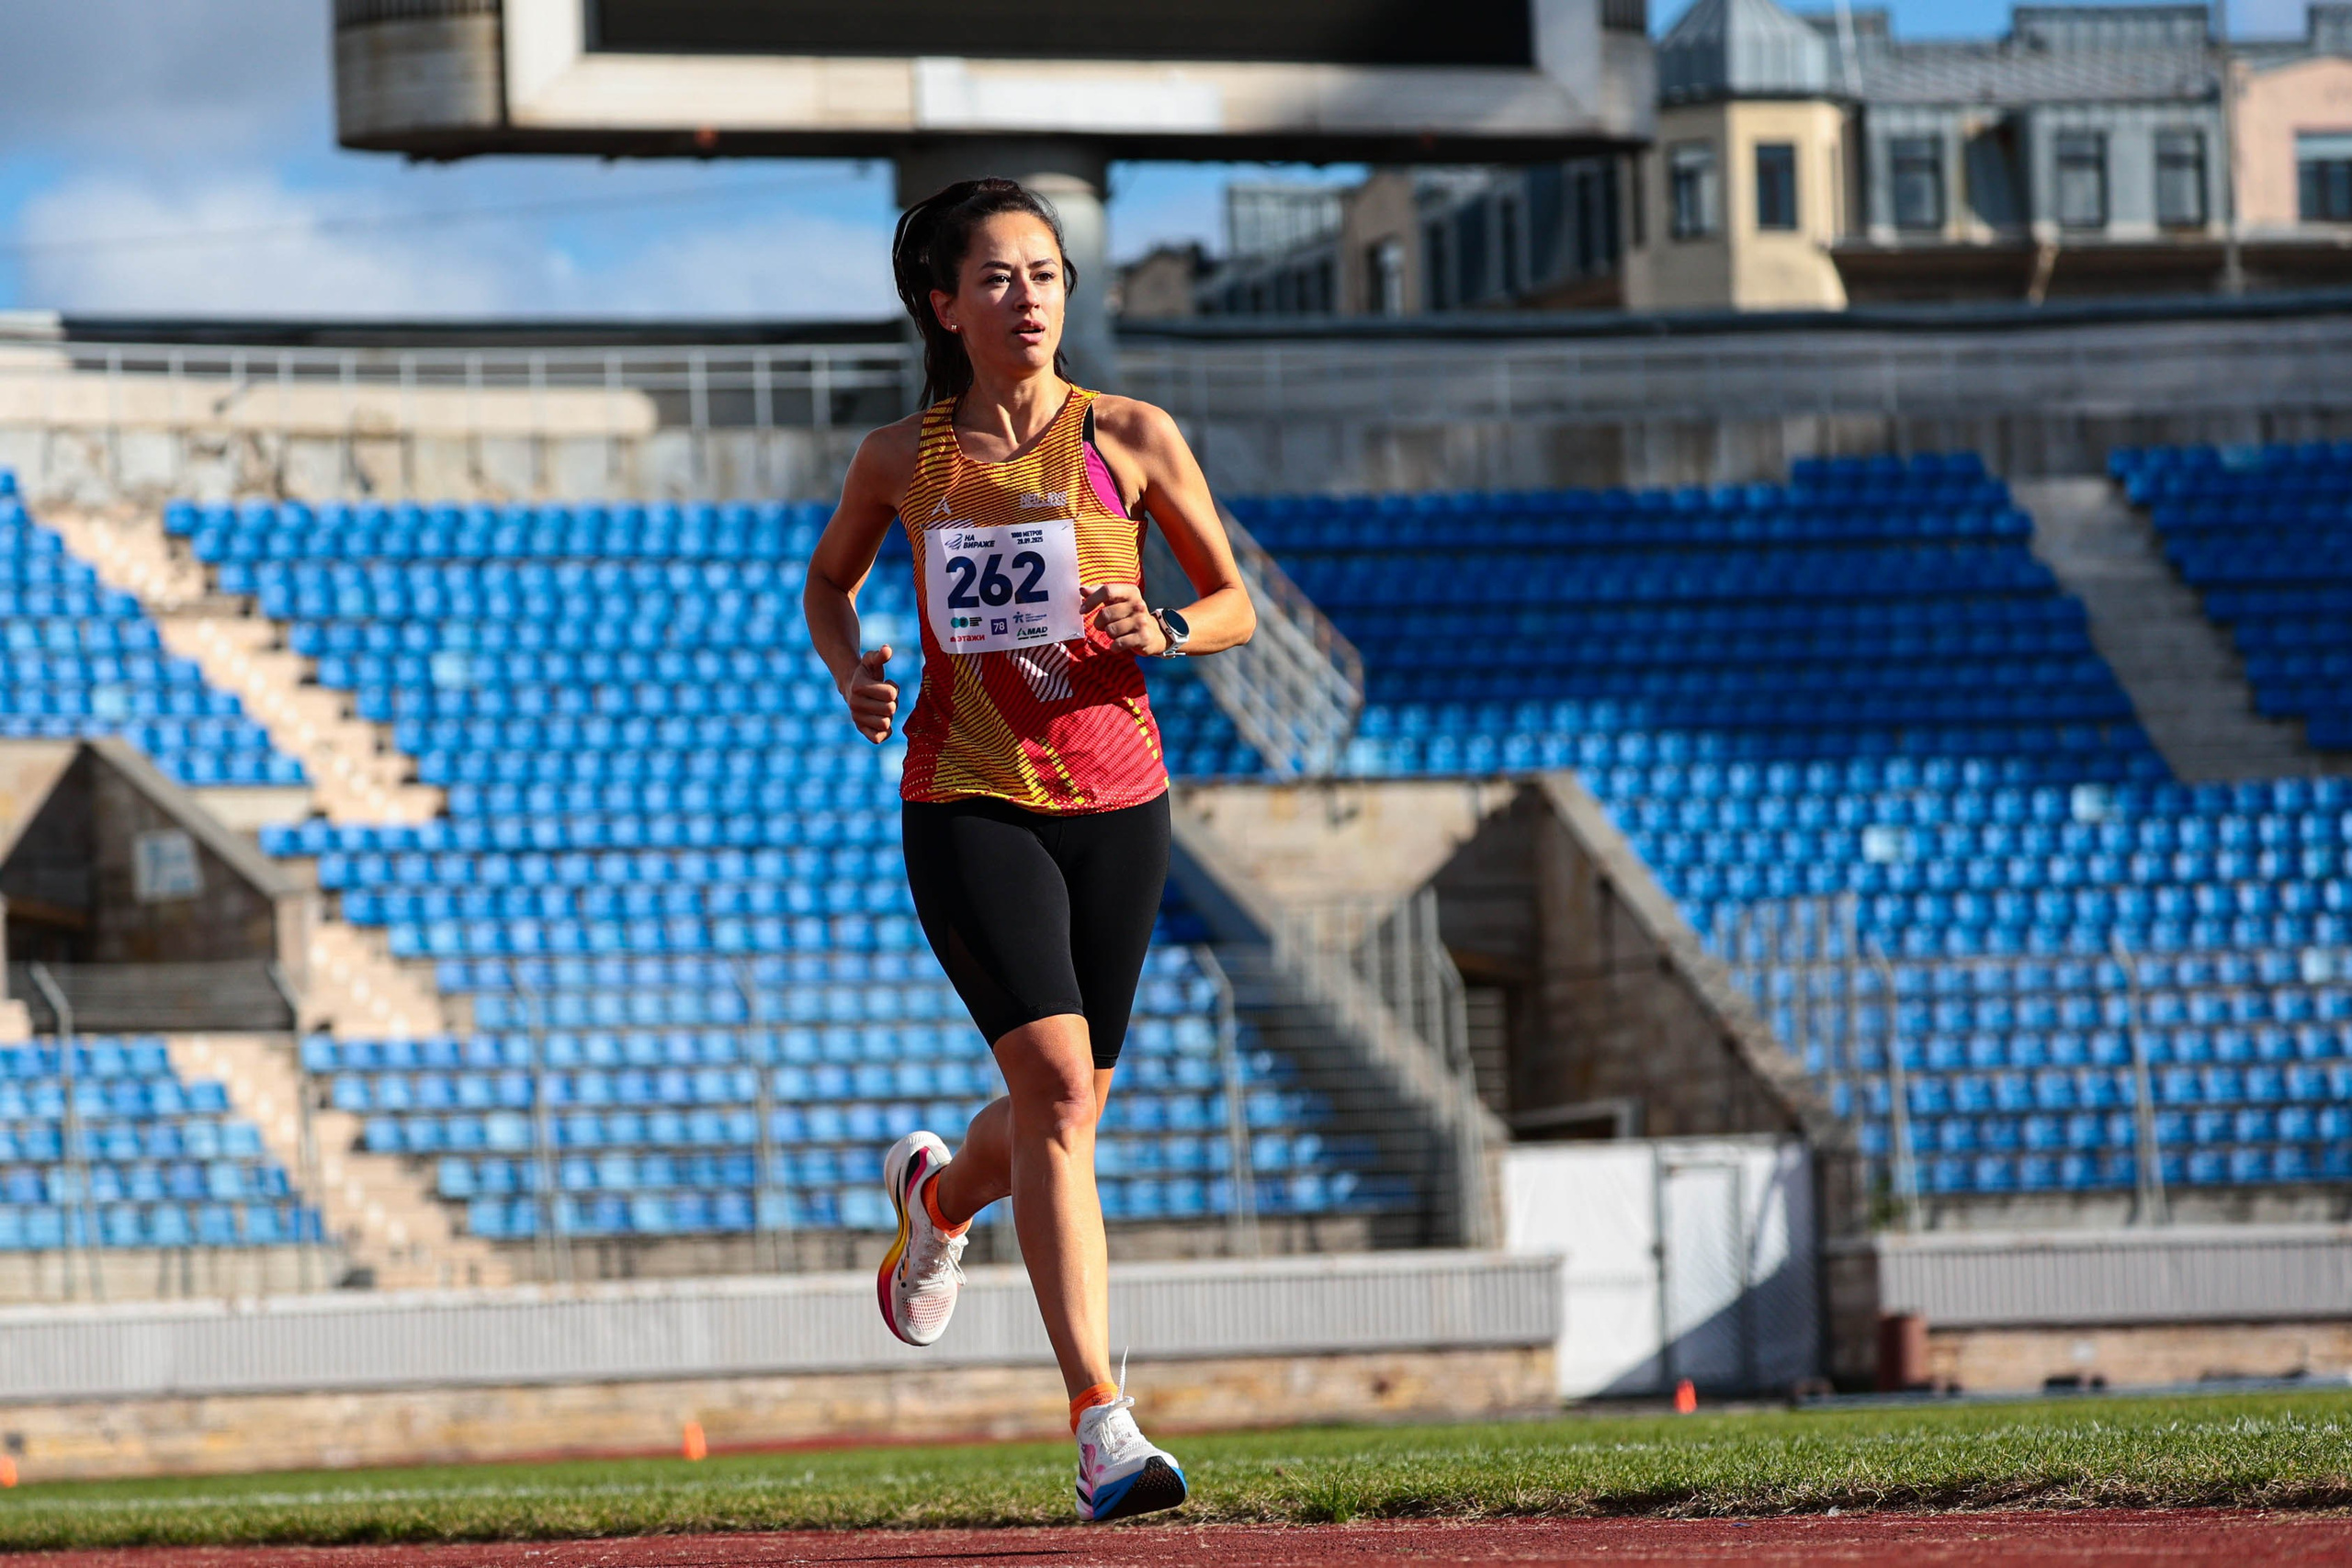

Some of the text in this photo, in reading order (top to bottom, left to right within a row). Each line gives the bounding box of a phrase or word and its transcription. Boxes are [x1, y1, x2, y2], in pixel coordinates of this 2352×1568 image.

[963, 540, 996, 548] ВИРАЖЕ
[945, 551, 1049, 609] 262
[993, 621, 1005, 632] 78
